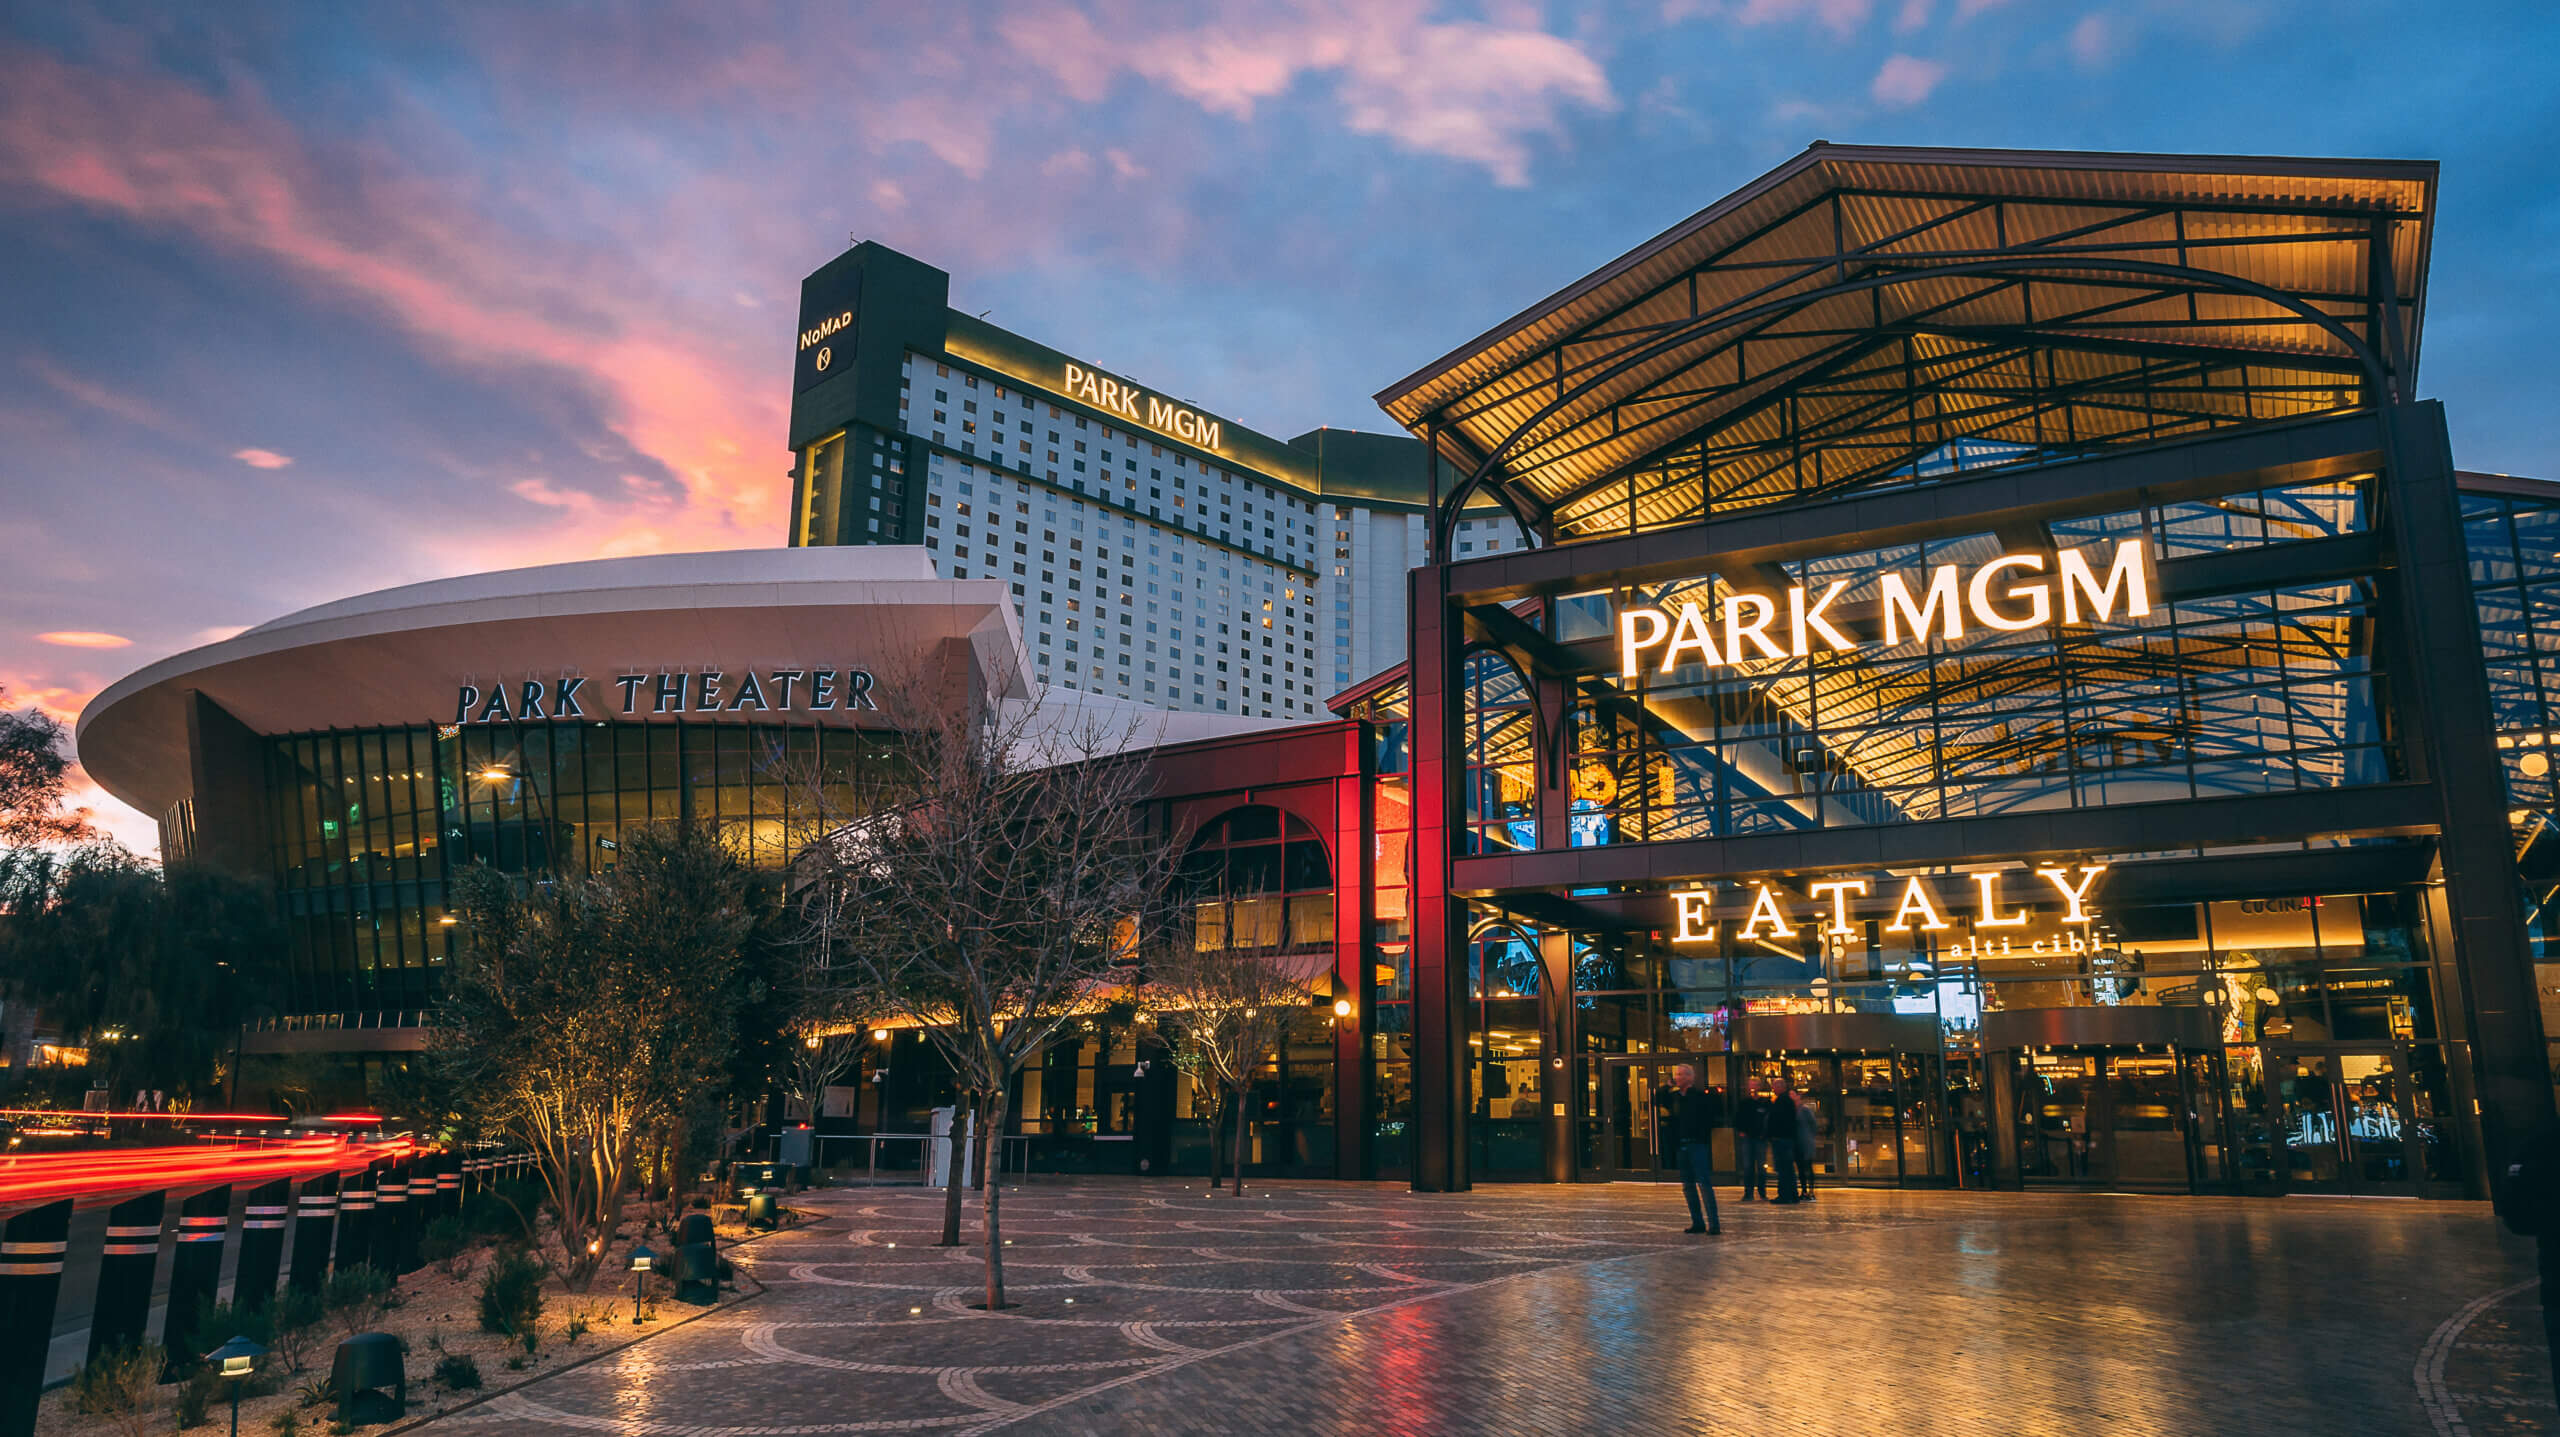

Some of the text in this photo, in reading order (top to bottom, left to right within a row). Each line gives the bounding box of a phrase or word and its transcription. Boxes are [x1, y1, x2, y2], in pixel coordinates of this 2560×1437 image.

[1064, 363, 1220, 450] PARK MGM
[1619, 539, 2151, 678] PARK MGM
[457, 671, 878, 724] PARK THEATER
[1670, 866, 2106, 943] EATALY
[1949, 930, 2103, 959] alti cibi
